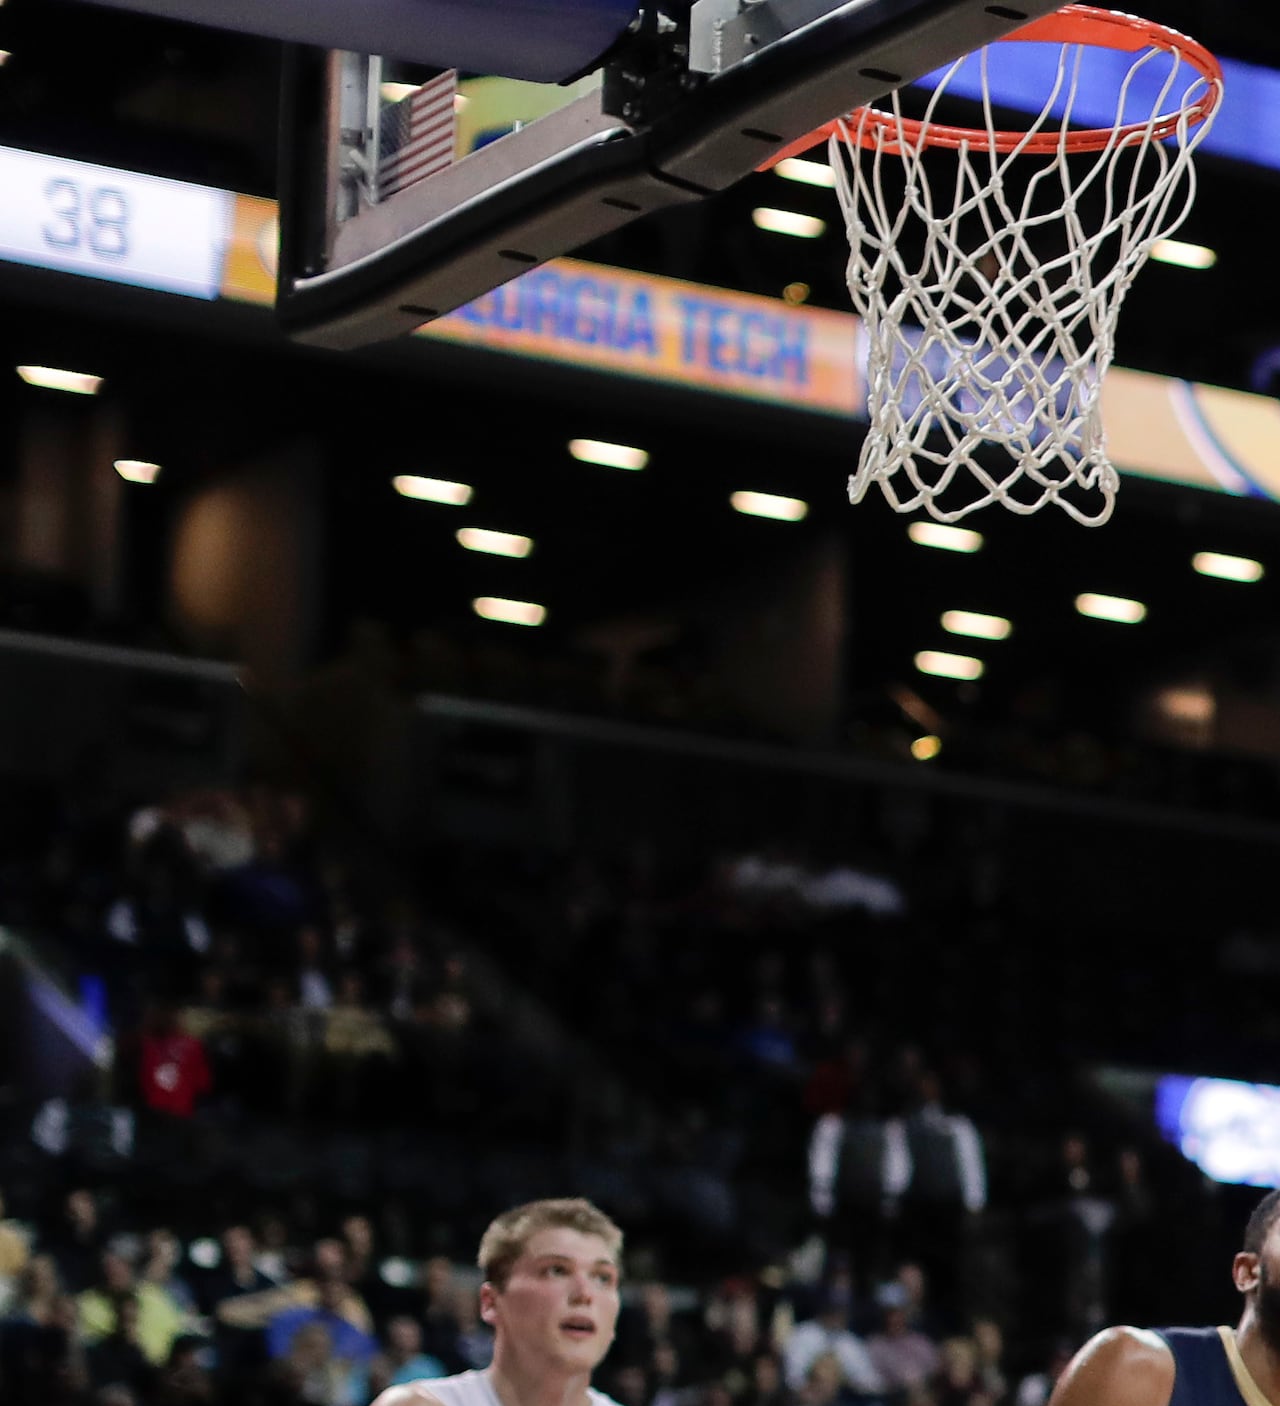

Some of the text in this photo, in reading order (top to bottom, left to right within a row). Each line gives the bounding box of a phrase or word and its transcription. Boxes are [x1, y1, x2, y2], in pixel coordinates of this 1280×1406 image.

[42, 174, 132, 262] 38
[457, 268, 811, 385] ORGIA TECH
